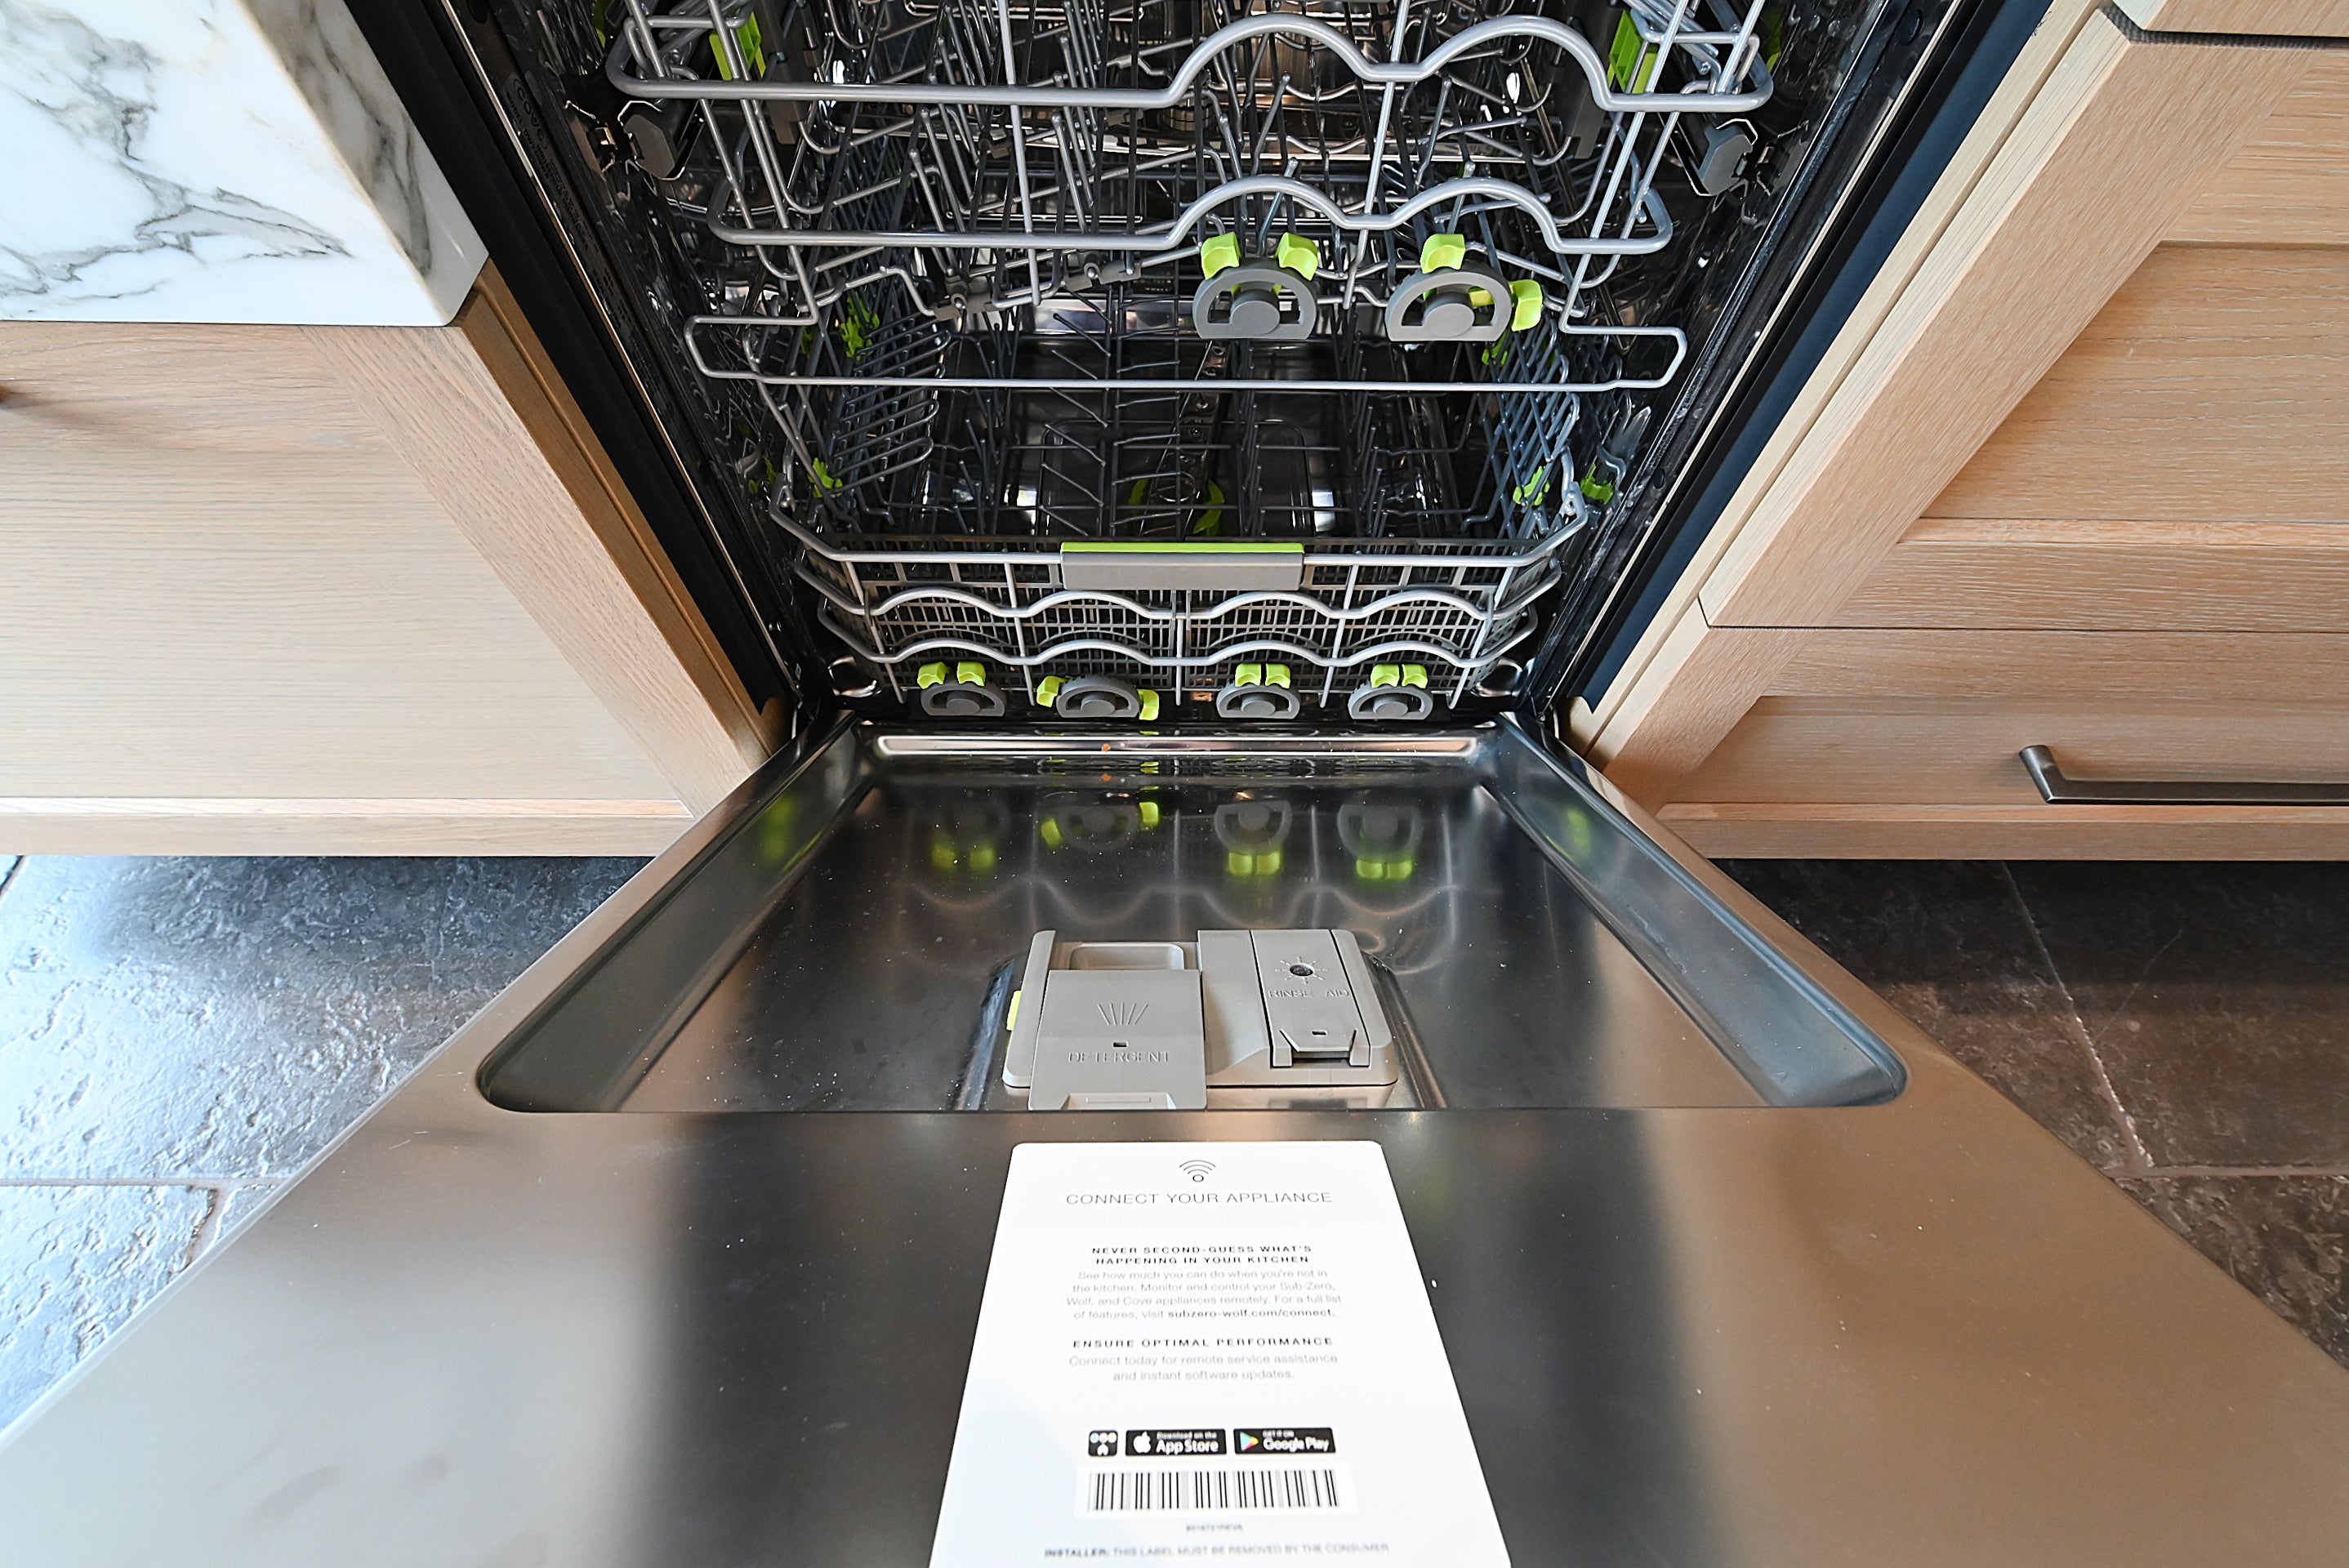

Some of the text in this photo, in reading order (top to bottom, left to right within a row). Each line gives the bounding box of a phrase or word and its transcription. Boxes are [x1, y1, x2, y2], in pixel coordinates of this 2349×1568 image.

[1268, 989, 1350, 998] RINSE AID
[1068, 1051, 1170, 1063] DETERGENT
[1067, 1193, 1331, 1204] CONNECT YOUR APPLIANCE
[1143, 1245, 1255, 1254] SECOND-GUESS
[1259, 1245, 1313, 1254] WHAT'S
[1096, 1257, 1177, 1265] HAPPENING
[1077, 1271, 1100, 1281] See
[1103, 1271, 1127, 1280] how
[1129, 1270, 1161, 1280] much
[1162, 1272, 1183, 1281] you
[1210, 1270, 1225, 1279] do
[1227, 1270, 1258, 1279] when
[1296, 1269, 1315, 1278] not
[1317, 1269, 1328, 1278] in
[1072, 1284, 1091, 1293] the
[1140, 1282, 1183, 1292] Monitor
[1186, 1282, 1208, 1292] and
[1210, 1281, 1250, 1291] control
[1252, 1283, 1277, 1293] your
[1097, 1296, 1120, 1306] and
[1122, 1296, 1152, 1306] Cove
[1155, 1295, 1217, 1307] appliances
[1273, 1294, 1293, 1304] For
[1306, 1294, 1323, 1304] full
[1325, 1294, 1342, 1303] list
[1073, 1311, 1085, 1319] of
[1142, 1310, 1164, 1318] visit
[1072, 1337, 1334, 1349] ENSURE OPTIMAL PERFORMANCE
[1068, 1352, 1339, 1368] Connect today for remote service assistance
[1112, 1370, 1137, 1382] and
[1139, 1370, 1182, 1381] instant
[1185, 1370, 1239, 1381] software
[1156, 1439, 1219, 1454] App Store
[1264, 1437, 1329, 1452] Google Play
